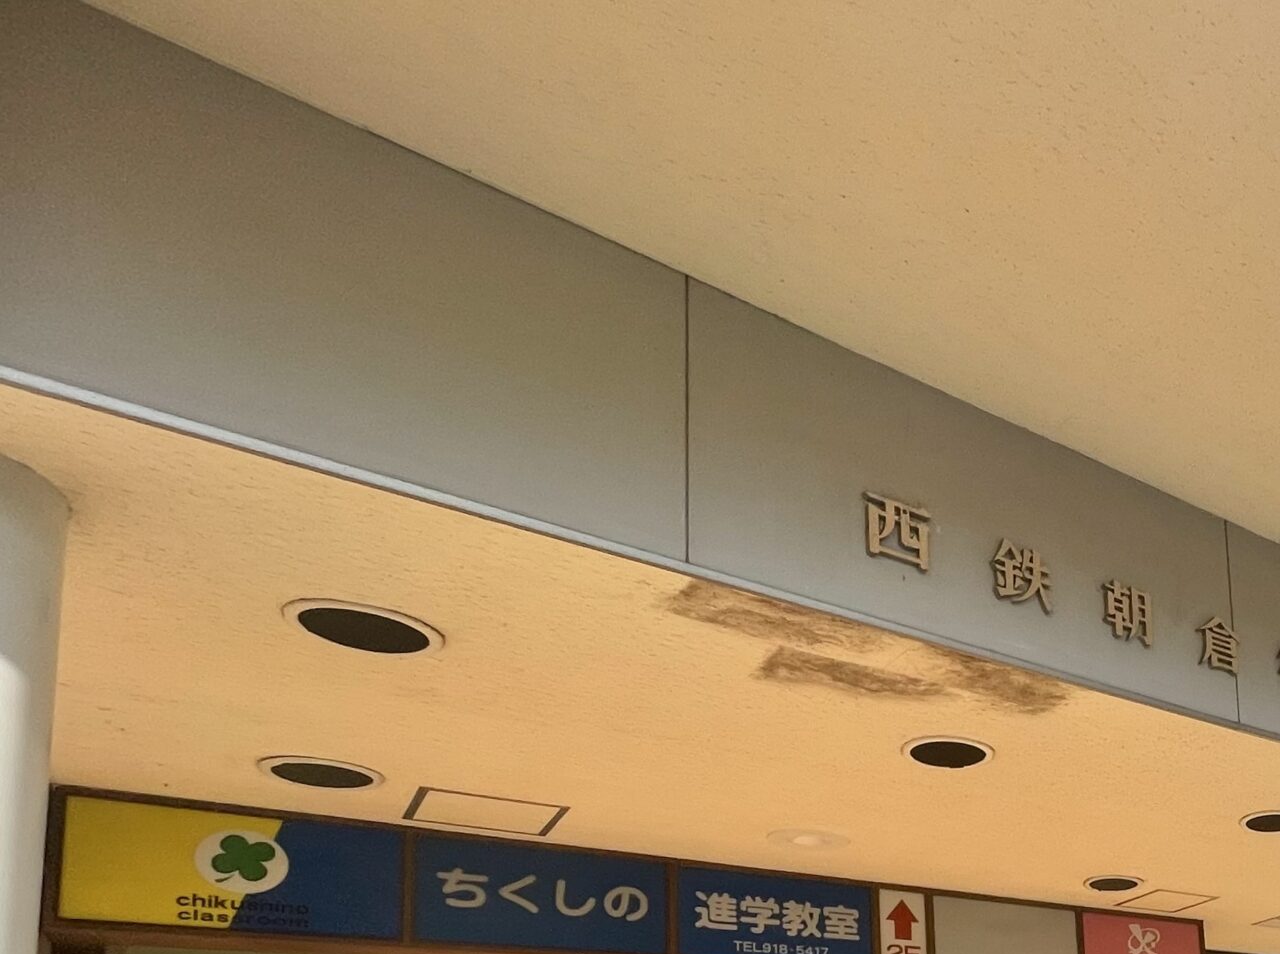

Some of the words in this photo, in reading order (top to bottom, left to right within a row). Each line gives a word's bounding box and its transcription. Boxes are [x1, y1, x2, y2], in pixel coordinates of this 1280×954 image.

[176, 894, 310, 915] chikushino
[436, 868, 648, 921] ちくしの
[695, 891, 860, 941] 進学教室
